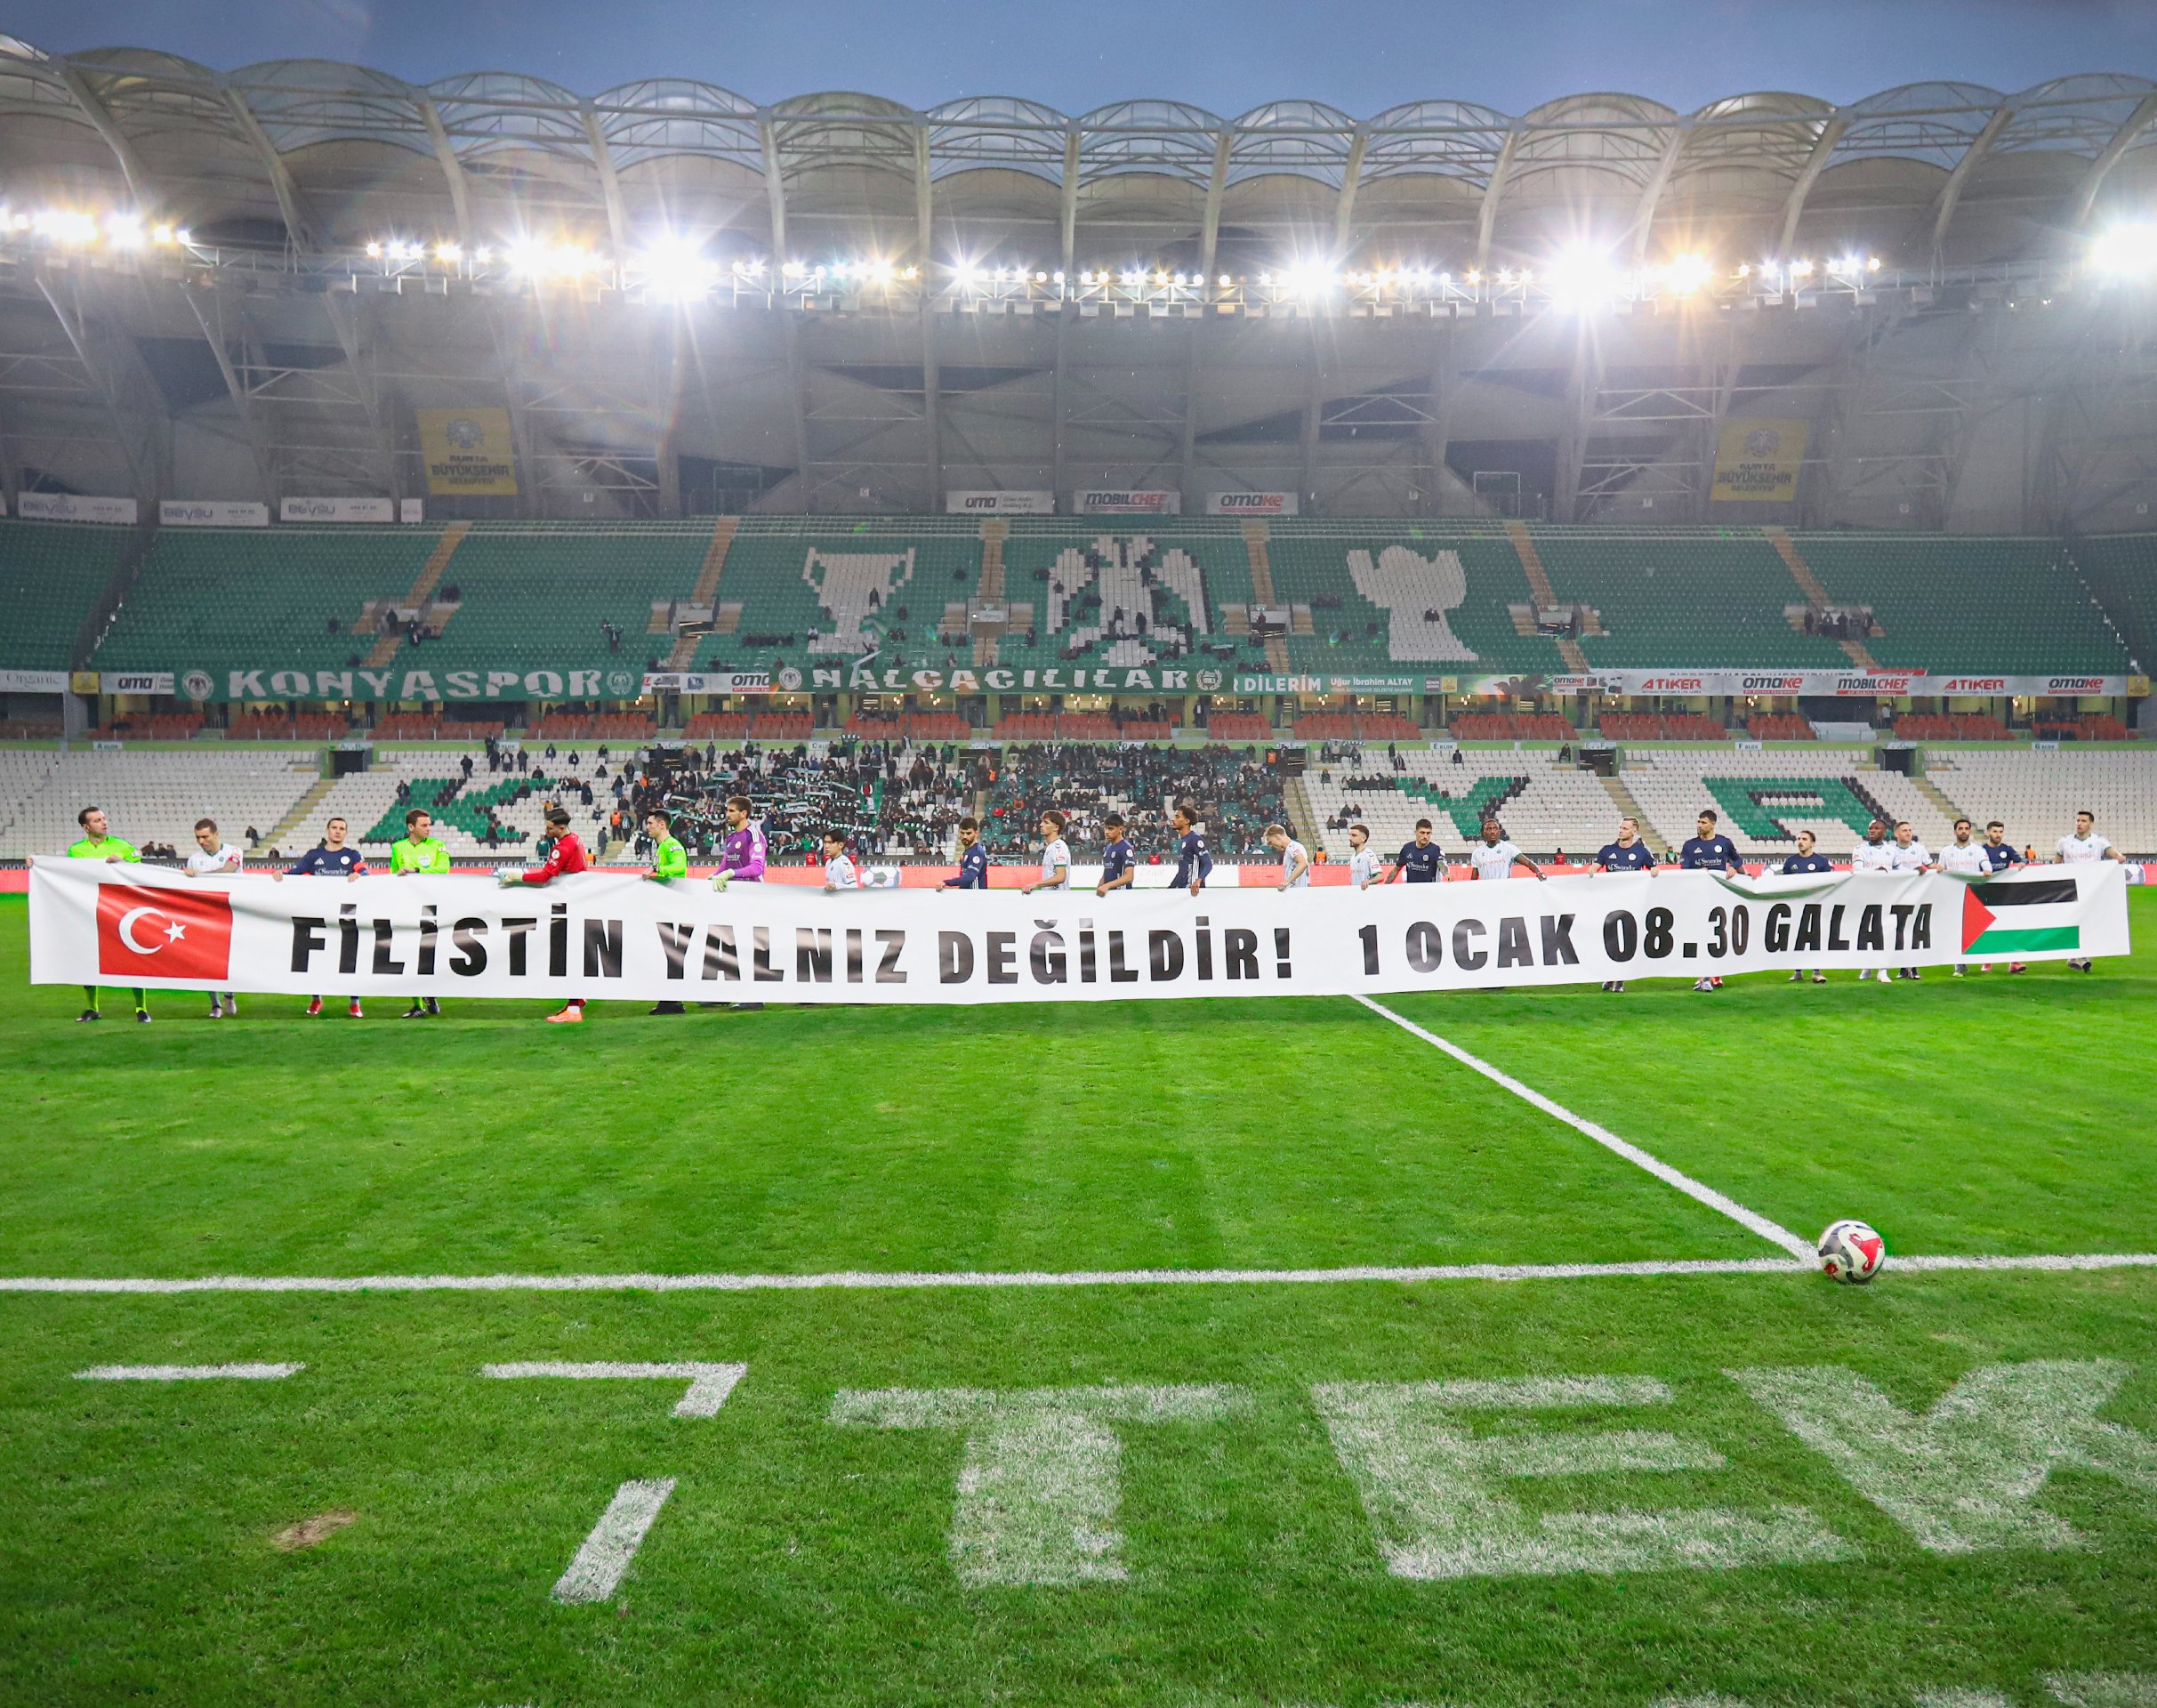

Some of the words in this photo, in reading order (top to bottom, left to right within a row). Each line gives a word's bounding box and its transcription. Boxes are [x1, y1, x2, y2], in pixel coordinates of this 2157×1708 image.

[118, 676, 153, 690] oma
[229, 669, 602, 699] KONYASPOR
[1244, 674, 1321, 692] DİLERİM
[1331, 677, 1350, 687] Uğur
[1353, 675, 1385, 686] İbrahim
[1388, 678, 1413, 686] ALTAY
[291, 902, 623, 979] FİLİSTİN
[656, 921, 908, 984] YALNIZ
[938, 915, 1292, 986] DEĞİLDİR!
[1357, 923, 1380, 976] 1
[1405, 913, 1581, 971] OCAK
[1603, 904, 1750, 963] 08.30
[1764, 902, 1933, 954] GALATA
